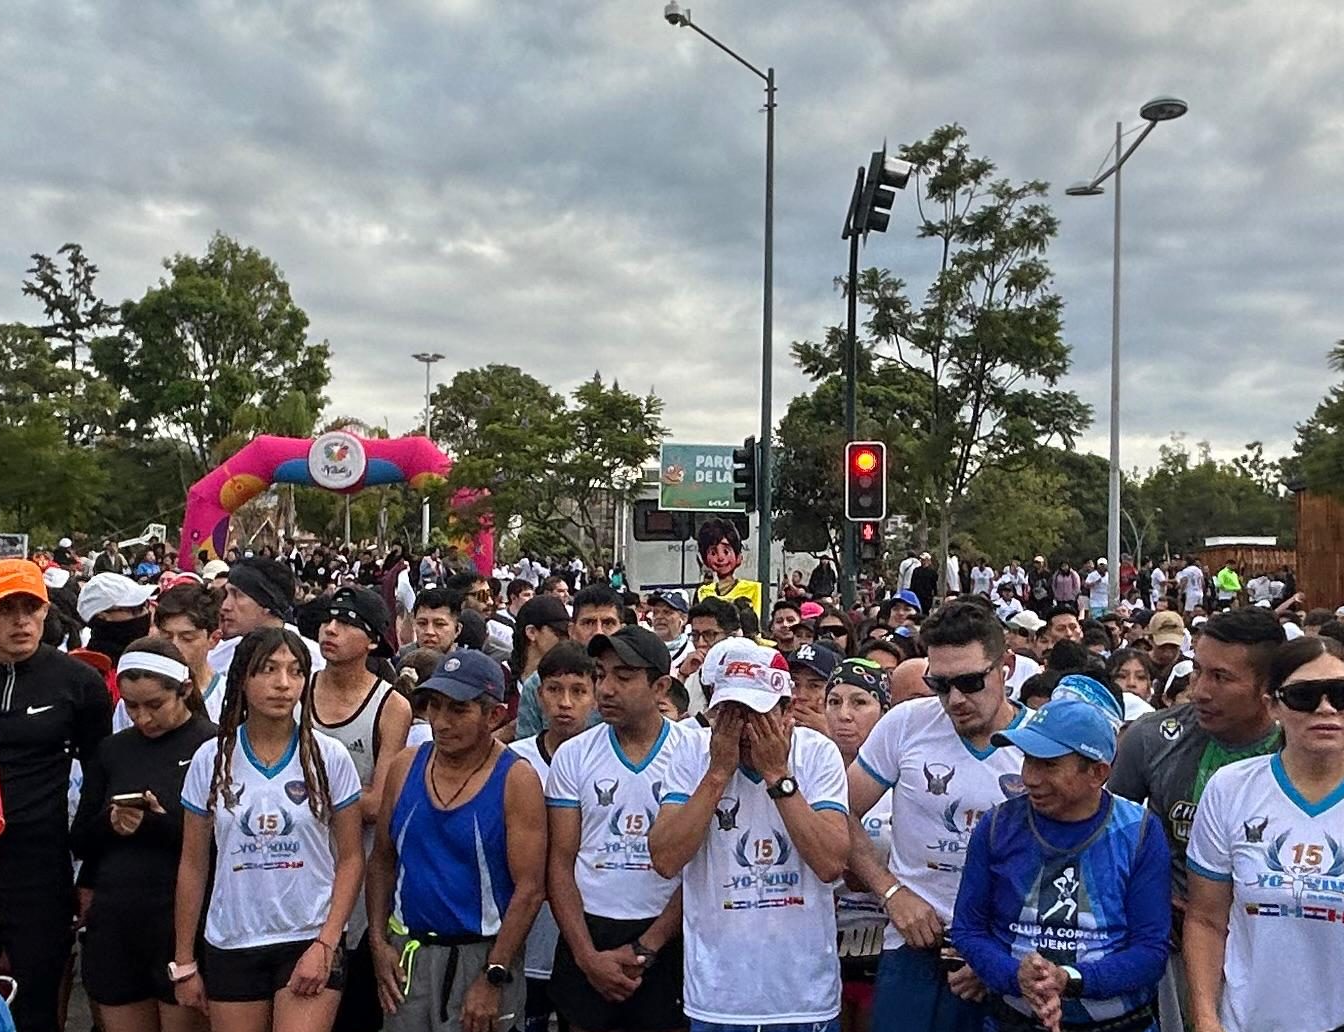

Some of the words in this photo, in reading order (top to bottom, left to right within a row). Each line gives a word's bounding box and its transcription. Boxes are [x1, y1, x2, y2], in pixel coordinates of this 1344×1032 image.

[696, 455, 733, 471] PARQ
[696, 470, 713, 482] DE
[716, 470, 733, 483] LA
[257, 814, 278, 829] 15
[625, 814, 644, 829] 15
[754, 839, 773, 858] 15
[1292, 843, 1324, 866] 15
[1257, 874, 1282, 888] YO
[1009, 923, 1041, 936] CLUB
[1044, 927, 1054, 936] A
[1031, 938, 1086, 951] CUENCA
